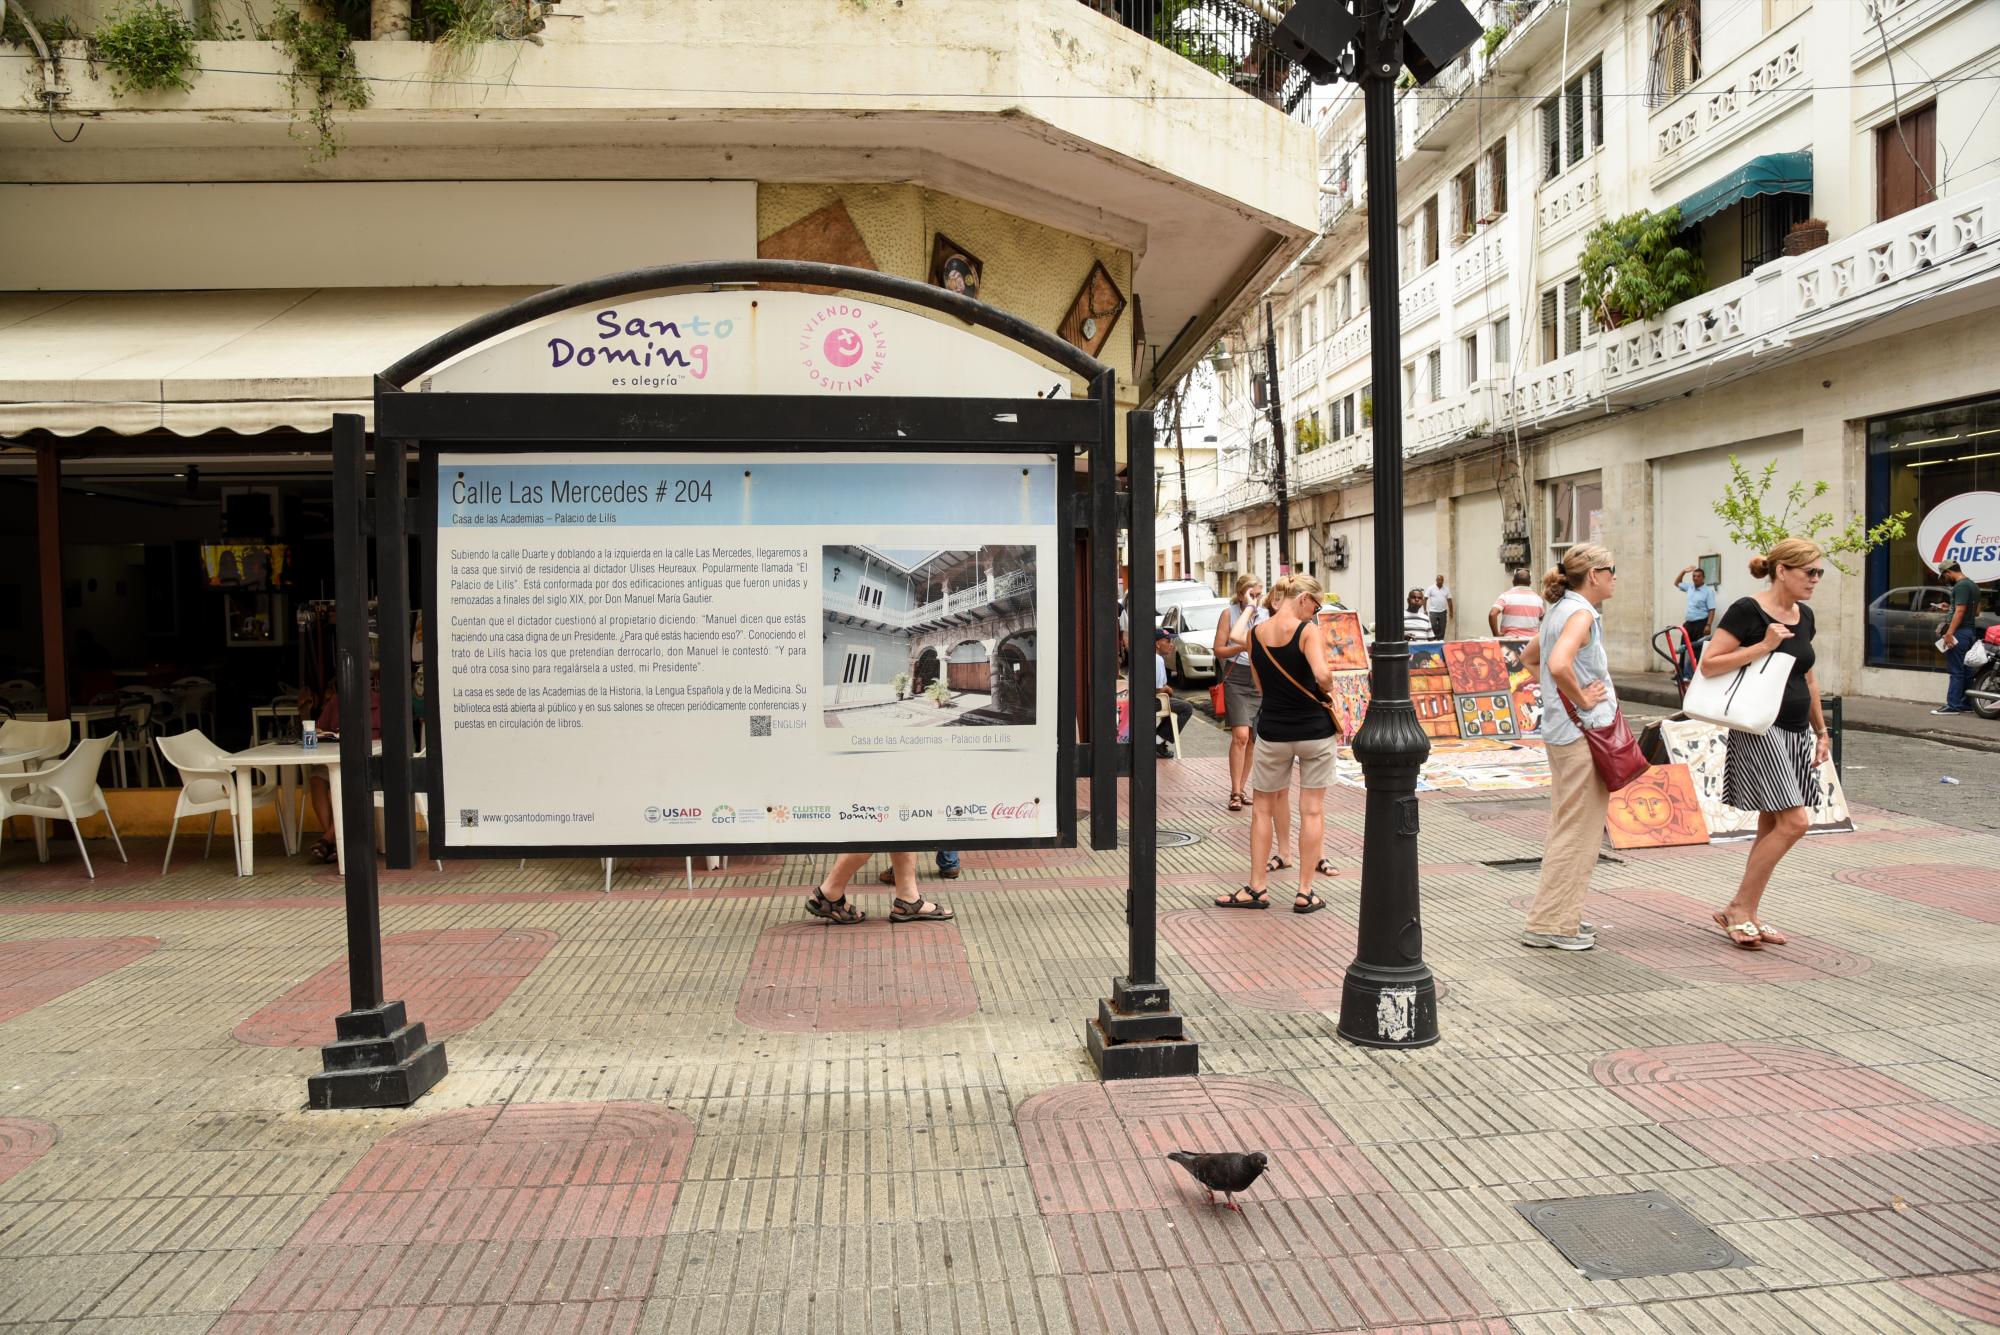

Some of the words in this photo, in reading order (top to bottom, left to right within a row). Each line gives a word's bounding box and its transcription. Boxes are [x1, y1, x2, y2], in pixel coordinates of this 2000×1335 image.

[597, 310, 734, 339] Santo
[799, 305, 862, 350] VIVIENDO
[801, 319, 887, 391] POSITIVAMENTE
[612, 377, 627, 386] es
[451, 480, 501, 504] Calle
[510, 480, 542, 503] Las
[551, 479, 647, 503] Mercedes
[655, 479, 667, 502] #
[675, 479, 712, 502] 204
[452, 513, 471, 524] Casa
[474, 514, 484, 523] de
[486, 514, 498, 523] las
[500, 513, 544, 523] Academias
[554, 513, 584, 523] Palacio
[586, 512, 596, 522] de
[599, 512, 616, 522] Lilís
[451, 549, 489, 559] Subiendo
[500, 549, 519, 559] calle
[521, 548, 548, 558] Duarte
[557, 548, 595, 558] doblando
[614, 548, 650, 560] izquierda
[652, 550, 662, 558] en
[674, 548, 693, 558] calle
[695, 548, 710, 557] Las
[756, 547, 801, 559] llegaremos
[1946, 545, 2000, 562] CUES
[460, 566, 479, 574] casa
[482, 566, 497, 576] que
[500, 564, 522, 574] sirvió
[525, 564, 535, 574] de
[538, 563, 580, 574] residencia
[593, 563, 626, 573] dictador
[629, 563, 655, 573] Ulises
[702, 562, 758, 574] Popularmente
[761, 562, 793, 572] llamada
[450, 579, 481, 589] Palacio
[483, 580, 493, 589] de
[523, 578, 540, 589] Está
[543, 578, 592, 589] conformada
[595, 580, 609, 590] por
[611, 578, 627, 588] dos
[629, 578, 684, 588] edificaciones
[687, 578, 722, 590] antiguas
[725, 579, 740, 590] que
[742, 577, 769, 587] fueron
[772, 577, 800, 587] unidas
[450, 595, 494, 606] remozadas
[503, 594, 529, 604] finales
[532, 594, 544, 604] del
[547, 594, 567, 606] siglo
[588, 595, 602, 605] por
[605, 593, 621, 603] Don
[624, 593, 654, 603] Manuel
[451, 615, 485, 626] Cuentan
[488, 617, 504, 627] que
[516, 615, 552, 625] dictador
[554, 615, 596, 625] cuestionó
[609, 615, 656, 626] propietario
[739, 613, 763, 623] dicen
[765, 615, 781, 625] que
[782, 613, 806, 623] estás
[451, 631, 487, 642] haciendo
[489, 633, 504, 641] una
[505, 633, 523, 641] casa
[525, 631, 547, 643] digna
[549, 631, 559, 641] de
[644, 631, 659, 642] qué
[660, 630, 681, 640] estás
[683, 630, 719, 640] haciendo
[748, 629, 796, 639] Conociendo
[451, 648, 470, 658] trato
[474, 648, 484, 657] de
[487, 647, 505, 657] Lilís
[508, 647, 531, 657] hacia
[534, 647, 547, 657] los
[550, 649, 566, 659] que
[569, 647, 613, 658] pretendían
[667, 646, 683, 656] don
[686, 646, 718, 655] Manuel
[788, 647, 806, 656] para
[452, 664, 467, 675] qué
[470, 664, 486, 673] otra
[489, 665, 508, 673] cosa
[511, 663, 529, 673] sino
[532, 665, 550, 675] para
[553, 663, 599, 674] regalársela
[453, 687, 462, 696] La
[464, 688, 482, 696] casa
[495, 687, 514, 696] sede
[516, 687, 526, 696] de
[528, 687, 540, 696] las
[541, 686, 586, 696] Academias
[587, 686, 598, 696] de
[655, 685, 684, 697] Lengua
[686, 684, 723, 696] Española
[732, 685, 742, 694] de
[453, 703, 490, 712] biblioteca
[492, 703, 508, 712] está
[510, 702, 536, 712] abierta
[547, 702, 576, 714] público
[585, 703, 594, 712] en
[597, 703, 611, 711] sus
[613, 702, 643, 711] salones
[645, 703, 654, 711] se
[656, 701, 684, 711] ofrecen
[687, 700, 746, 712] periódicamente
[748, 700, 799, 710] conferencias
[454, 719, 485, 730] puestas
[487, 720, 497, 728] en
[499, 718, 543, 728] circulación
[545, 718, 555, 728] de
[772, 719, 807, 729] ENGLISH
[662, 807, 702, 818] USAID
[852, 803, 890, 812] Santo
[911, 809, 933, 818] ADN
[482, 811, 595, 824] www.gosantodomingo.travel
[711, 816, 737, 824] CDCT
[839, 811, 889, 823] Domingo
